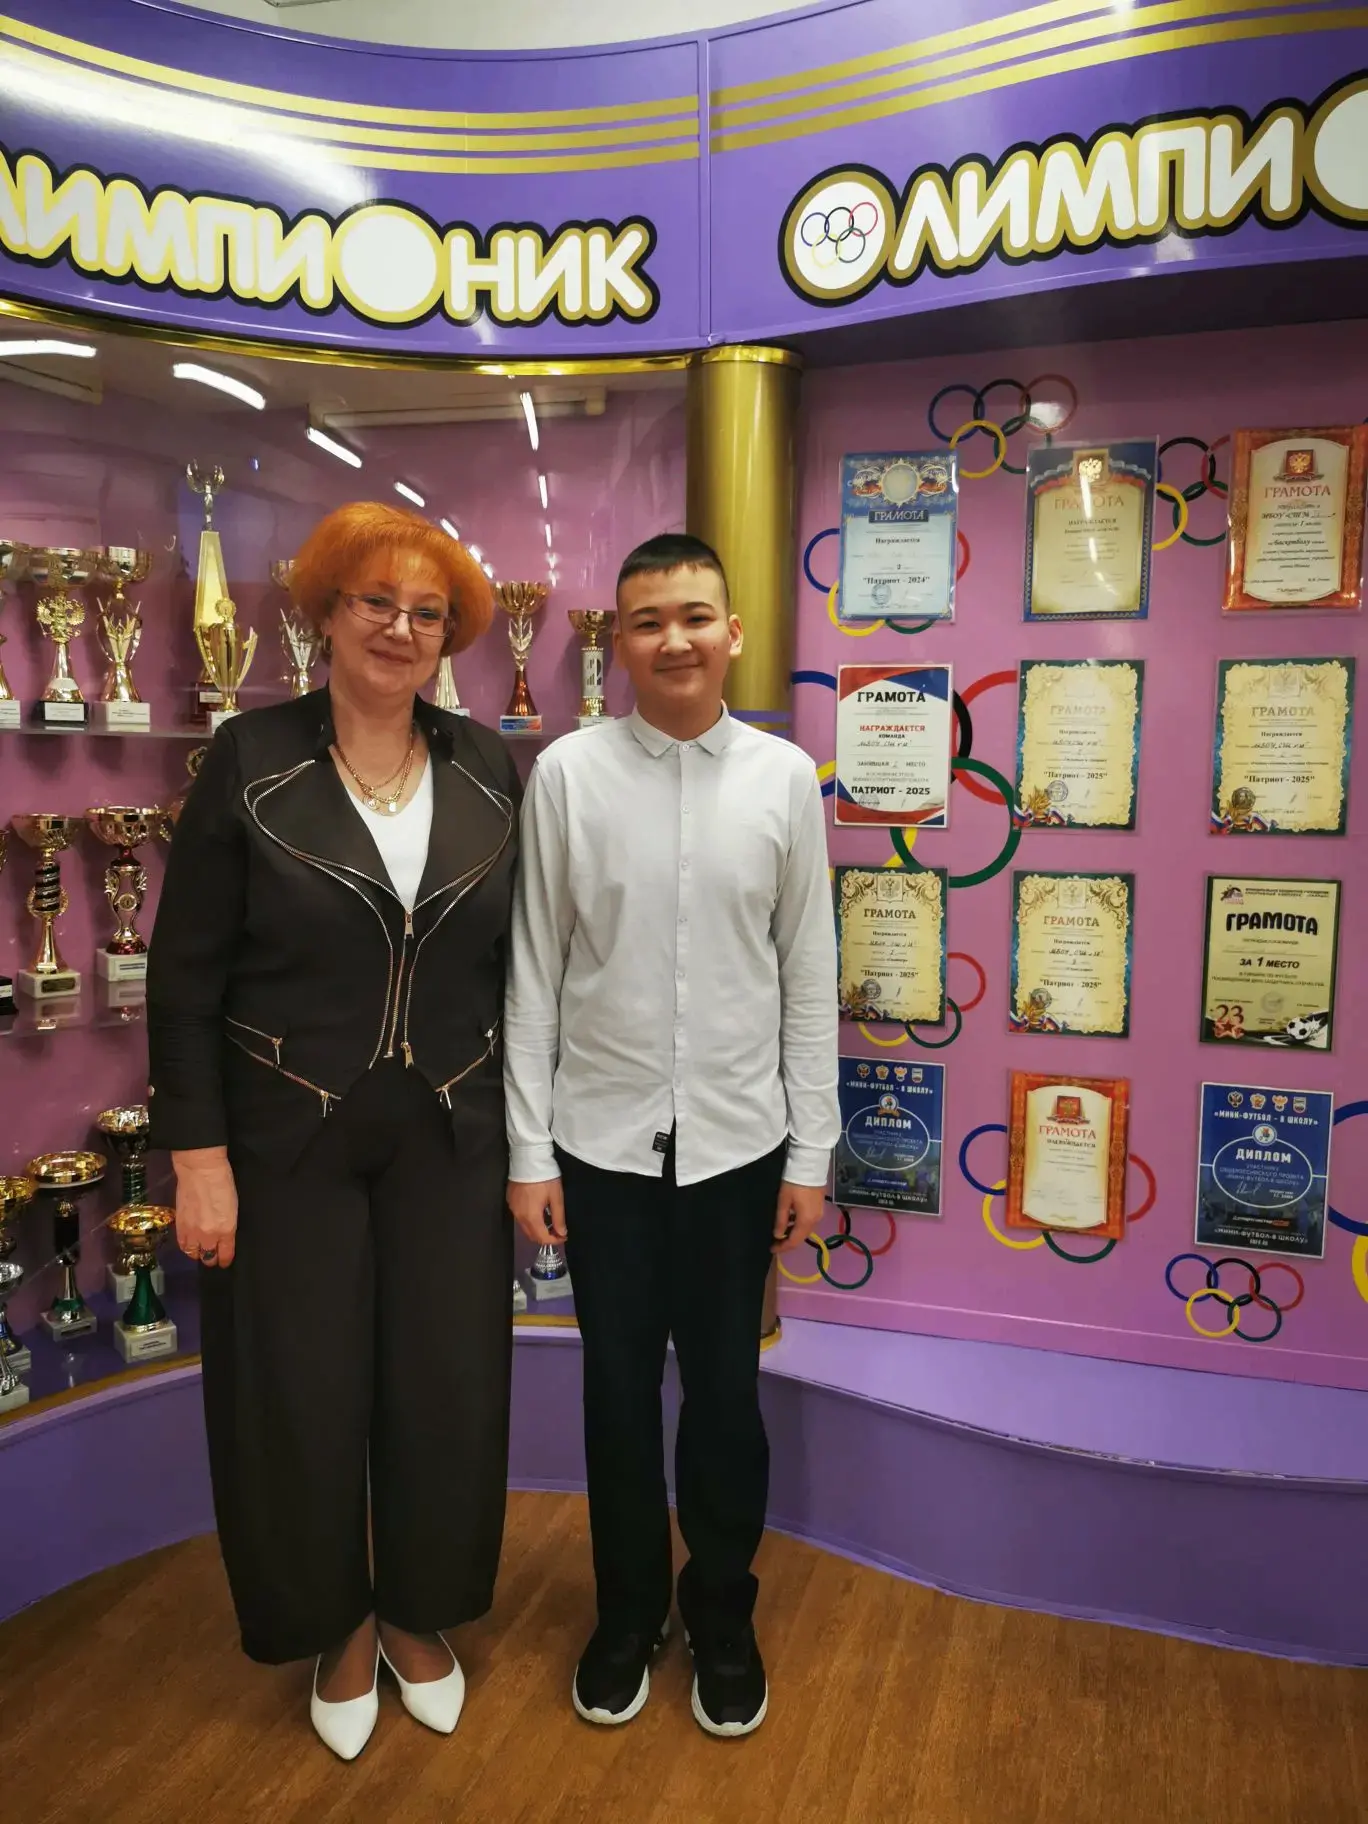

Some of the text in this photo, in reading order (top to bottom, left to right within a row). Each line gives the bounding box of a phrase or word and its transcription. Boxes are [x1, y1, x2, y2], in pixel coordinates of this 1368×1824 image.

[1264, 485, 1331, 498] ГРАМОТА
[1054, 495, 1124, 511] ГРАОТА
[874, 510, 925, 522] ГРАМОТА
[857, 691, 926, 703] ГРАМОТА
[1251, 706, 1316, 718] ГРАМОТА
[851, 786, 896, 795] ПАТРИОТ
[906, 787, 930, 795] 2025
[864, 909, 916, 920] ГРАМОТА
[1044, 916, 1100, 928] ГРАМОТА
[1226, 912, 1318, 936] ГРАМОТА
[1240, 956, 1300, 968] ЗА 1 МЕСТО
[1216, 1004, 1244, 1024] 23
[865, 1116, 912, 1130] ДИПЛОМ
[1039, 1125, 1096, 1140] ГРАМОТА
[1236, 1148, 1291, 1164] ДИПЛОМ
